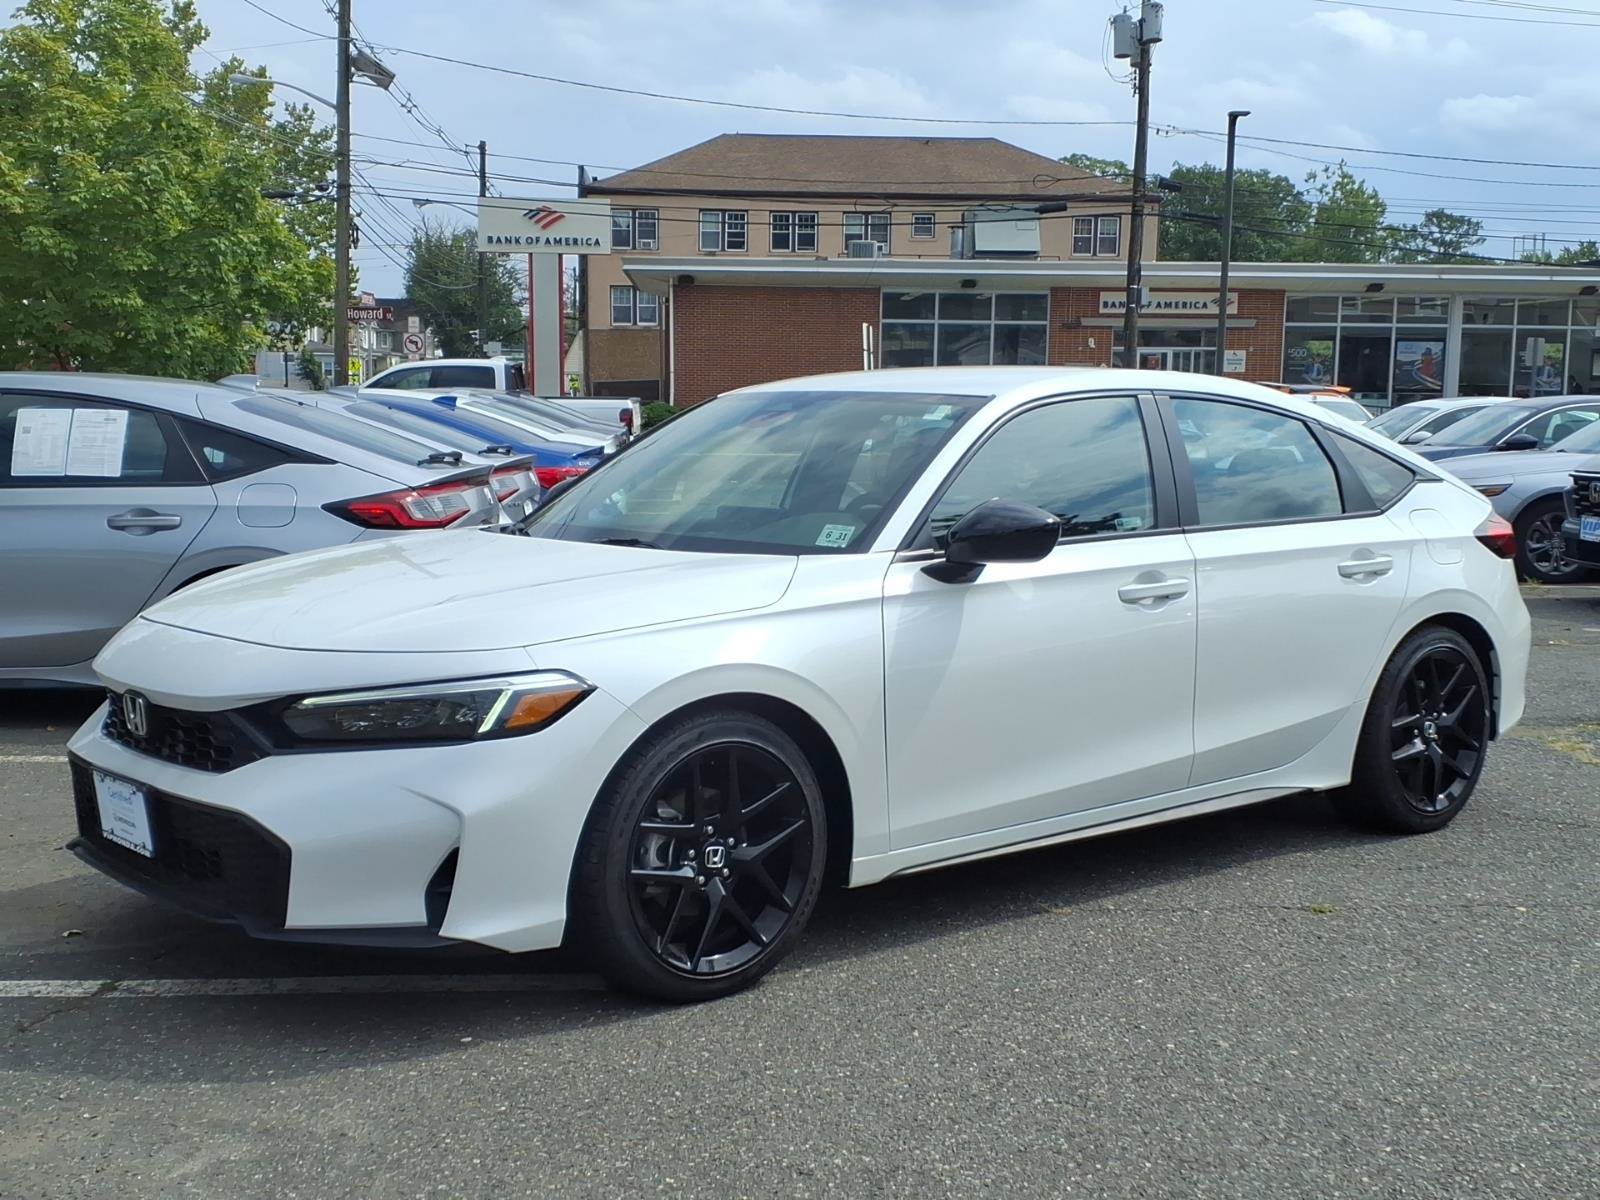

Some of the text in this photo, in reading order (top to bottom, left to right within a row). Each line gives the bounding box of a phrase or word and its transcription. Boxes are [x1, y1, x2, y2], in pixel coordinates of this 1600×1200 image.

[487, 235, 601, 246] BANK OF AMERICA
[1102, 300, 1127, 309] BAN
[1155, 301, 1208, 310] AMERICA
[347, 308, 383, 319] Howard
[1582, 520, 1600, 532] VIP
[825, 531, 848, 541] 6 31
